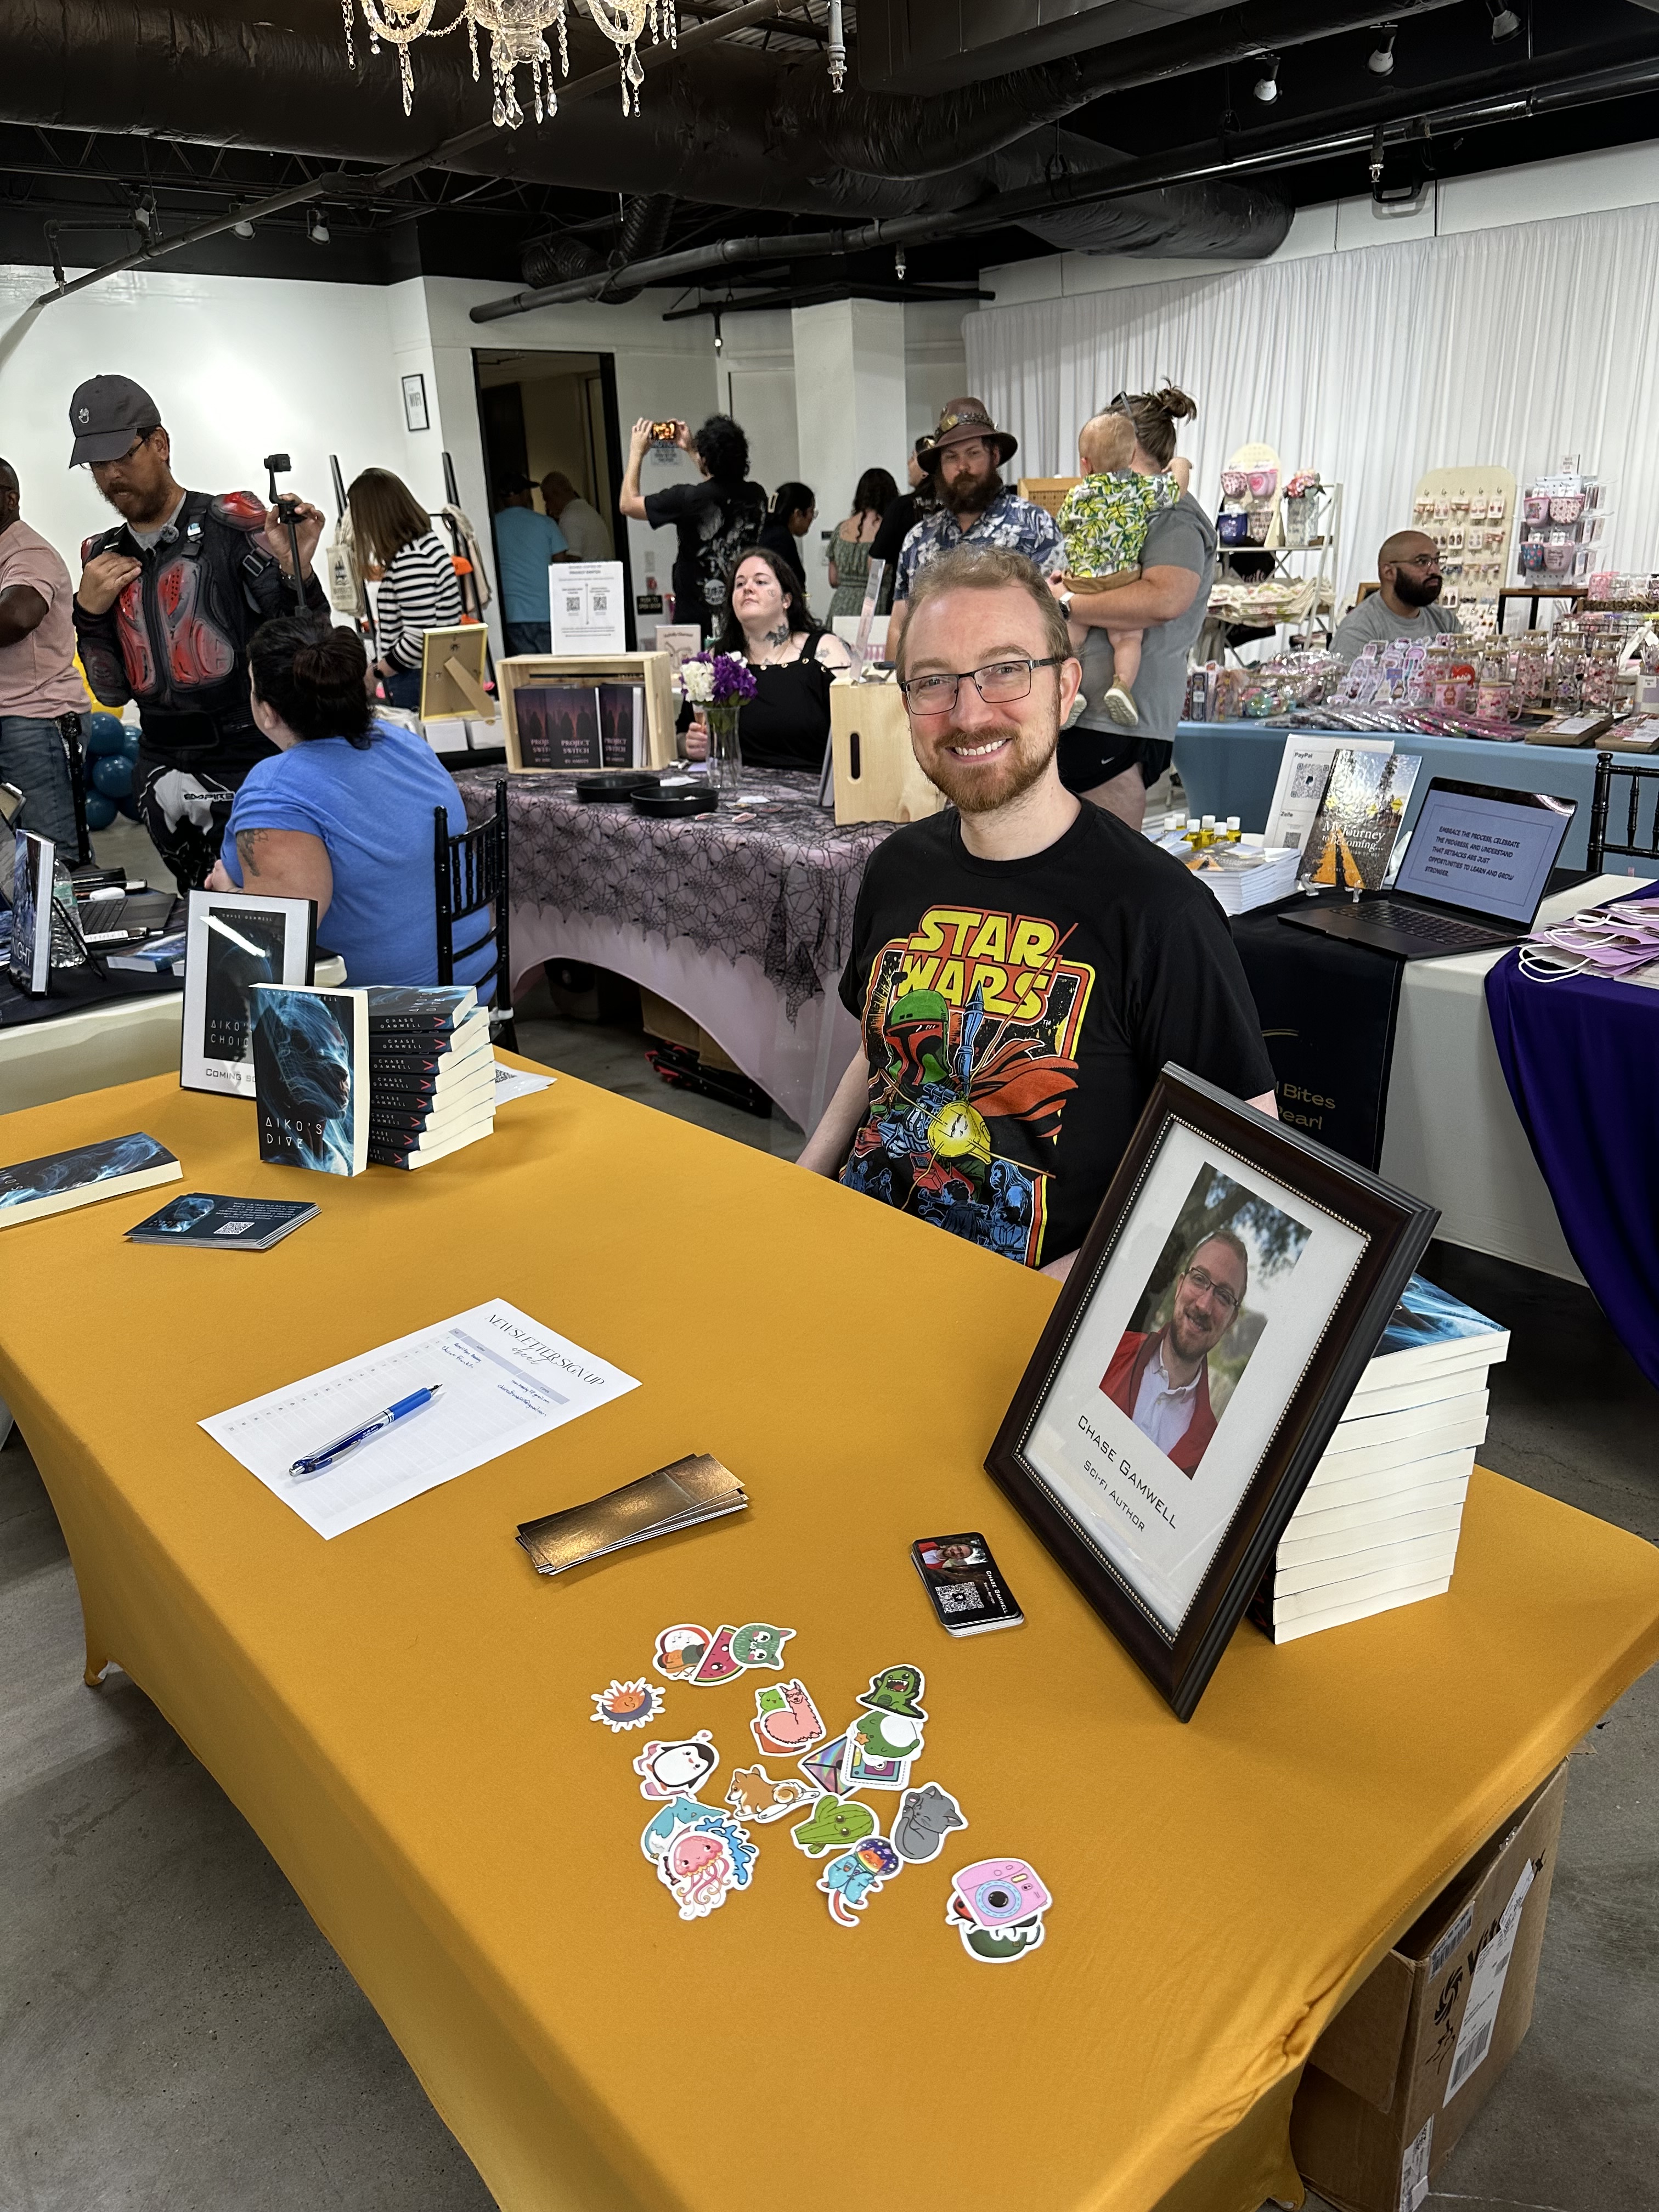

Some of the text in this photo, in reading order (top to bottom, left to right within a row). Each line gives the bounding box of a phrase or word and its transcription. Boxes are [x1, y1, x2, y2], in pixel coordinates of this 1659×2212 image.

[1342, 824, 1385, 843] Journey
[1439, 826, 1461, 836] EMBRACE
[1471, 833, 1492, 843] PROCESS,
[1493, 838, 1520, 848] CELEBRATE
[1444, 838, 1469, 849] PROGRESS,
[1481, 846, 1513, 858] UNDERSTAND
[1444, 849, 1467, 859] SETBACKS
[1428, 856, 1463, 869] OPPORTUNITIES
[1470, 866, 1487, 876] LEARN
[1498, 872, 1514, 881] GROW
[908, 910, 1058, 971] STAR
[896, 954, 1052, 1020] WARS
[211, 1034, 249, 1047] CHOIC
[1283, 1083, 1336, 1109] Bites
[267, 1133, 303, 1149] DIVE
[485, 1314, 561, 1363] NEWSLETTER
[556, 1358, 589, 1378] SIGN
[583, 1373, 605, 1385] UP
